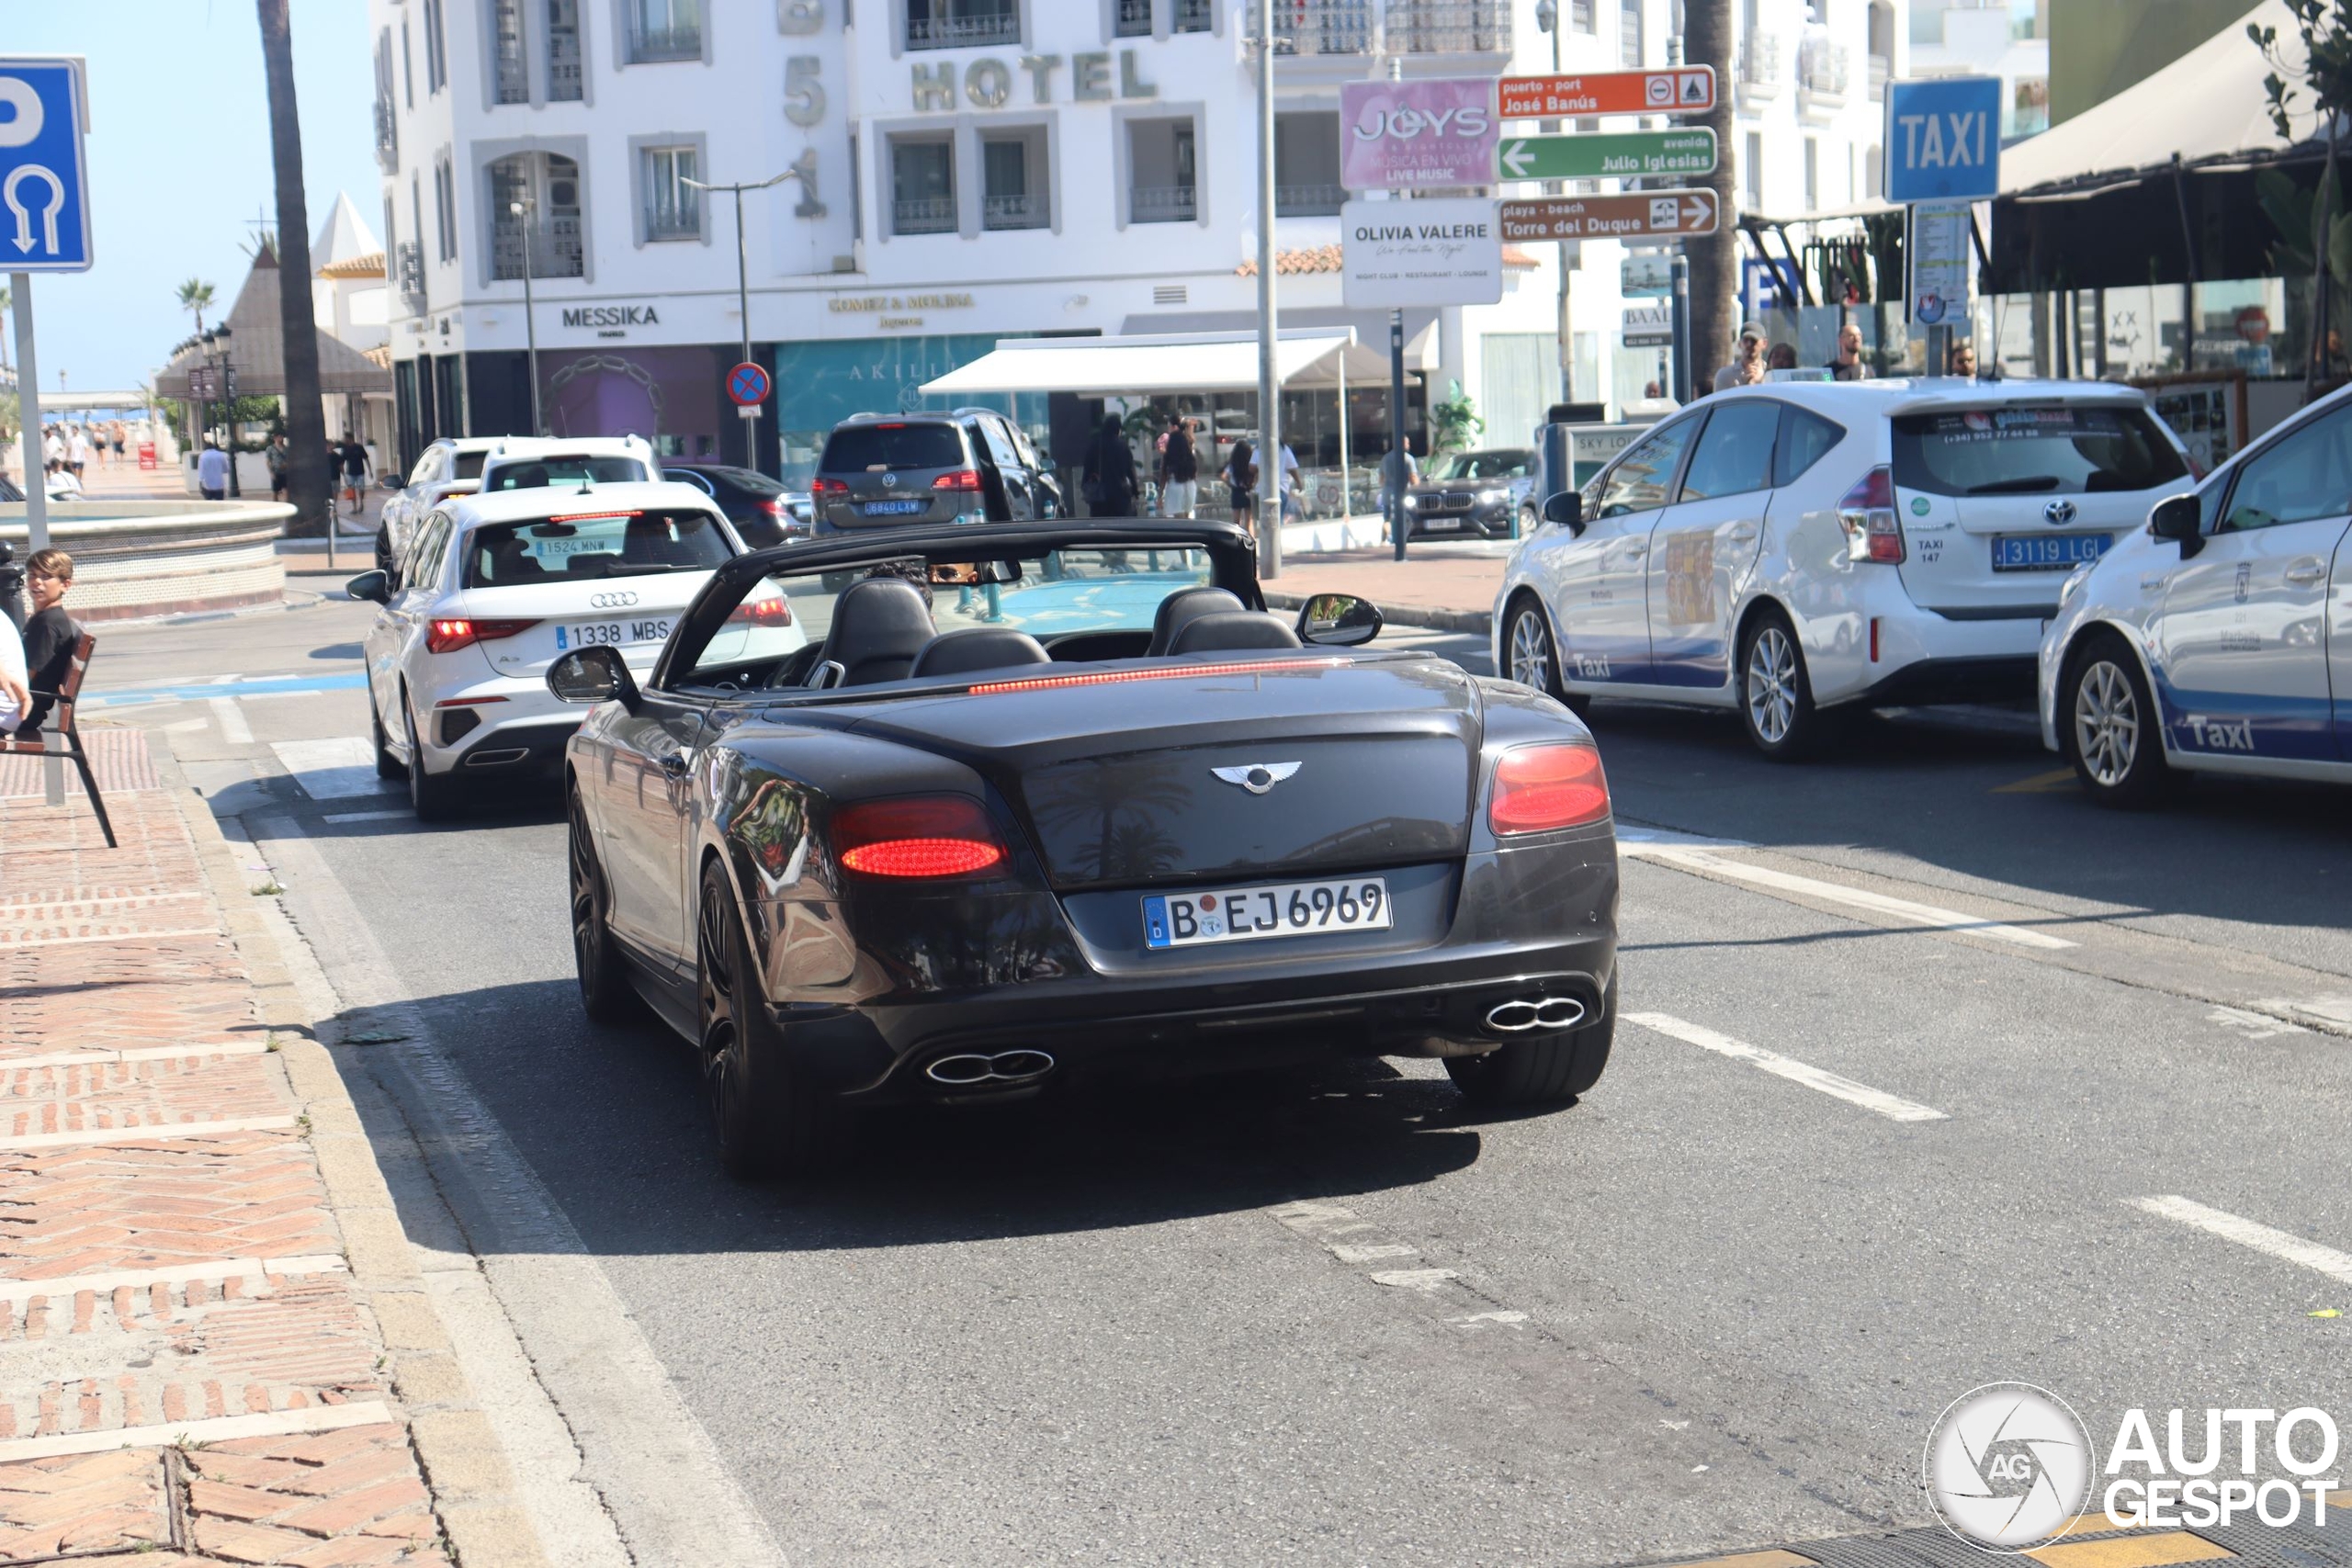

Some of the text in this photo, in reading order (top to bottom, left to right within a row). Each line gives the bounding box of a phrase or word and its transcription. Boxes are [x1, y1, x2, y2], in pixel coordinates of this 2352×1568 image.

[911, 49, 1159, 112] HOTEL
[1503, 80, 1544, 95] puerto
[1555, 78, 1581, 92] port
[1504, 94, 1598, 113] José Banús
[1352, 106, 1489, 141] JOYS
[1663, 136, 1710, 149] avenida
[1898, 111, 1986, 169] TAXI
[1421, 154, 1439, 167] EN
[1440, 152, 1471, 166] VIVO
[1601, 152, 1710, 172] Julio Iglesias
[1385, 167, 1455, 182] LIVE MUSIC
[1502, 204, 1536, 218] playa
[1547, 201, 1585, 215] beach
[1355, 223, 1488, 242] OLIVIA VALERE
[1503, 218, 1642, 236] Torre del Duque
[1355, 272, 1378, 280] NIGHT
[1405, 270, 1453, 279] RESTAURANT
[1458, 269, 1488, 277] LOUNGE
[561, 305, 660, 327] MESSIKA
[1579, 437, 1603, 449] SKY
[1943, 433, 1972, 445] (+34)
[1996, 431, 2007, 439] 77
[548, 540, 605, 554] 1524 MNW
[1918, 539, 1944, 550] TAXI
[2011, 539, 2060, 563] 3119
[1922, 552, 1940, 563] 147
[573, 621, 670, 646] 1338 MBS
[1573, 653, 1611, 678] Taxi
[2187, 714, 2256, 750] Taxi
[1170, 900, 1198, 939] B
